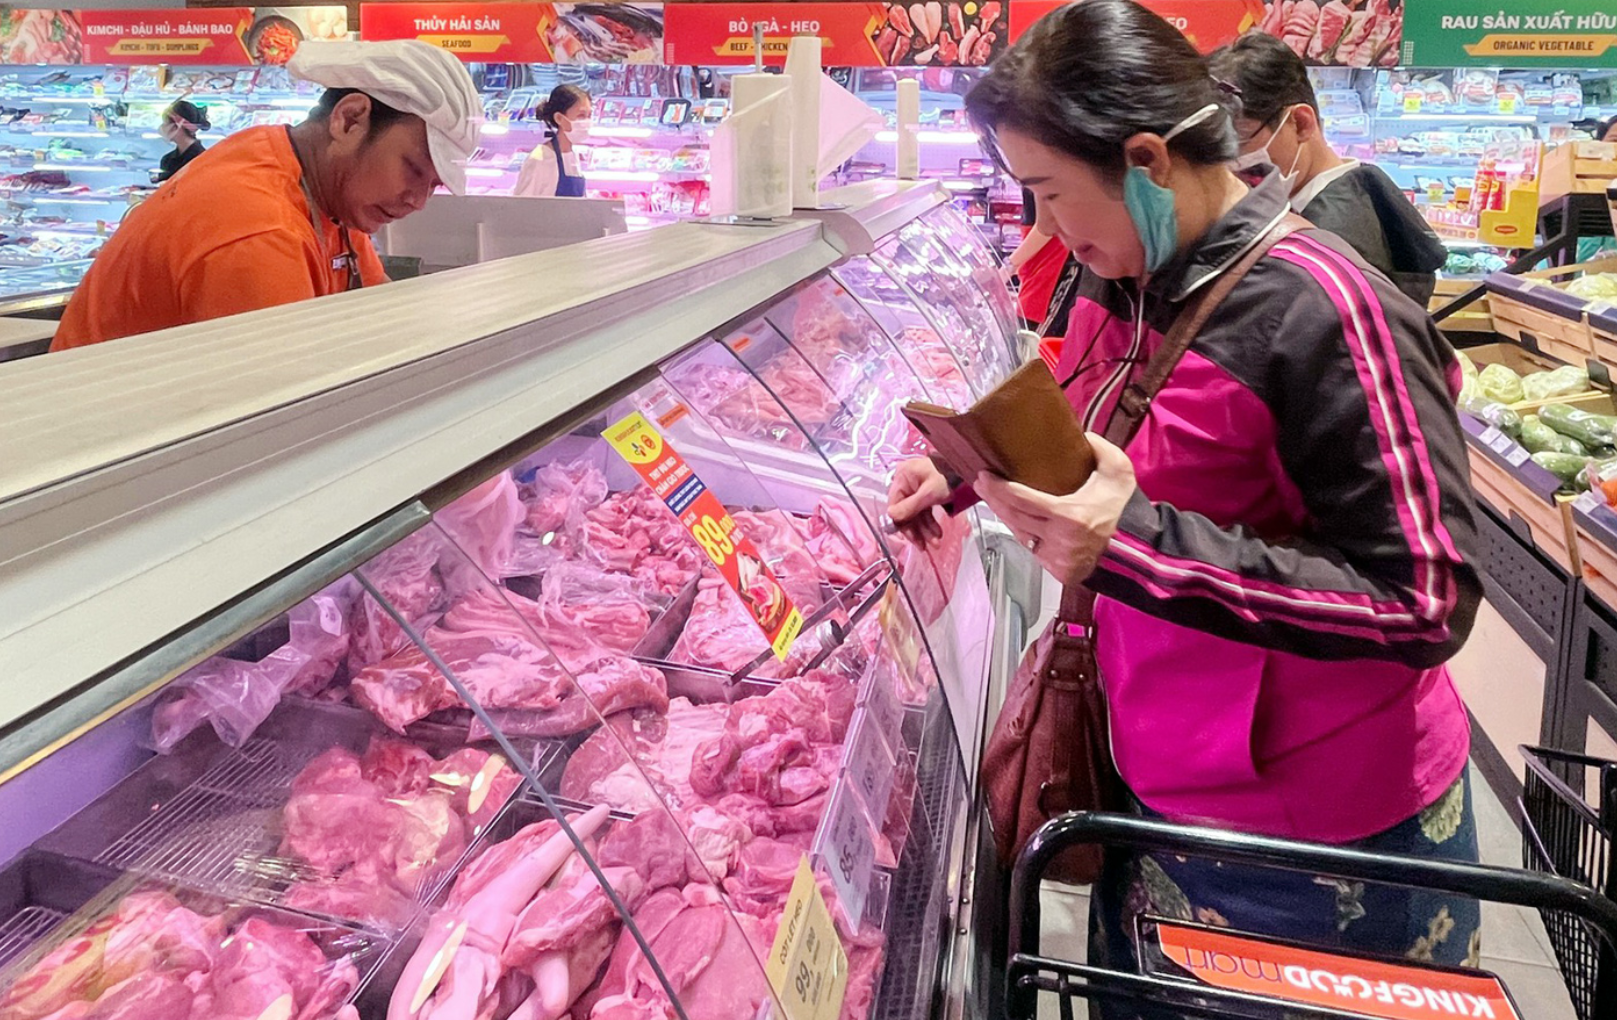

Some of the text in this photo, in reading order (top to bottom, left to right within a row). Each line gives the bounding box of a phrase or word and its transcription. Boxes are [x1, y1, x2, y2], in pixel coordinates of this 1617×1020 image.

[414, 15, 500, 30] THỦY HẢI SẢN
[1442, 10, 1617, 29] RAU SẢN XUẤT HỮU
[87, 25, 124, 35] KIMCHI
[131, 21, 153, 37] ĐẬU
[155, 21, 170, 34] HỦ
[178, 21, 208, 34] BÁNH
[210, 24, 233, 34] BAO
[790, 21, 820, 33] HEO
[442, 40, 471, 48] SEAFOOD
[730, 42, 749, 51] BEEF
[1493, 41, 1594, 50] ORGANIC VEGETABLE
